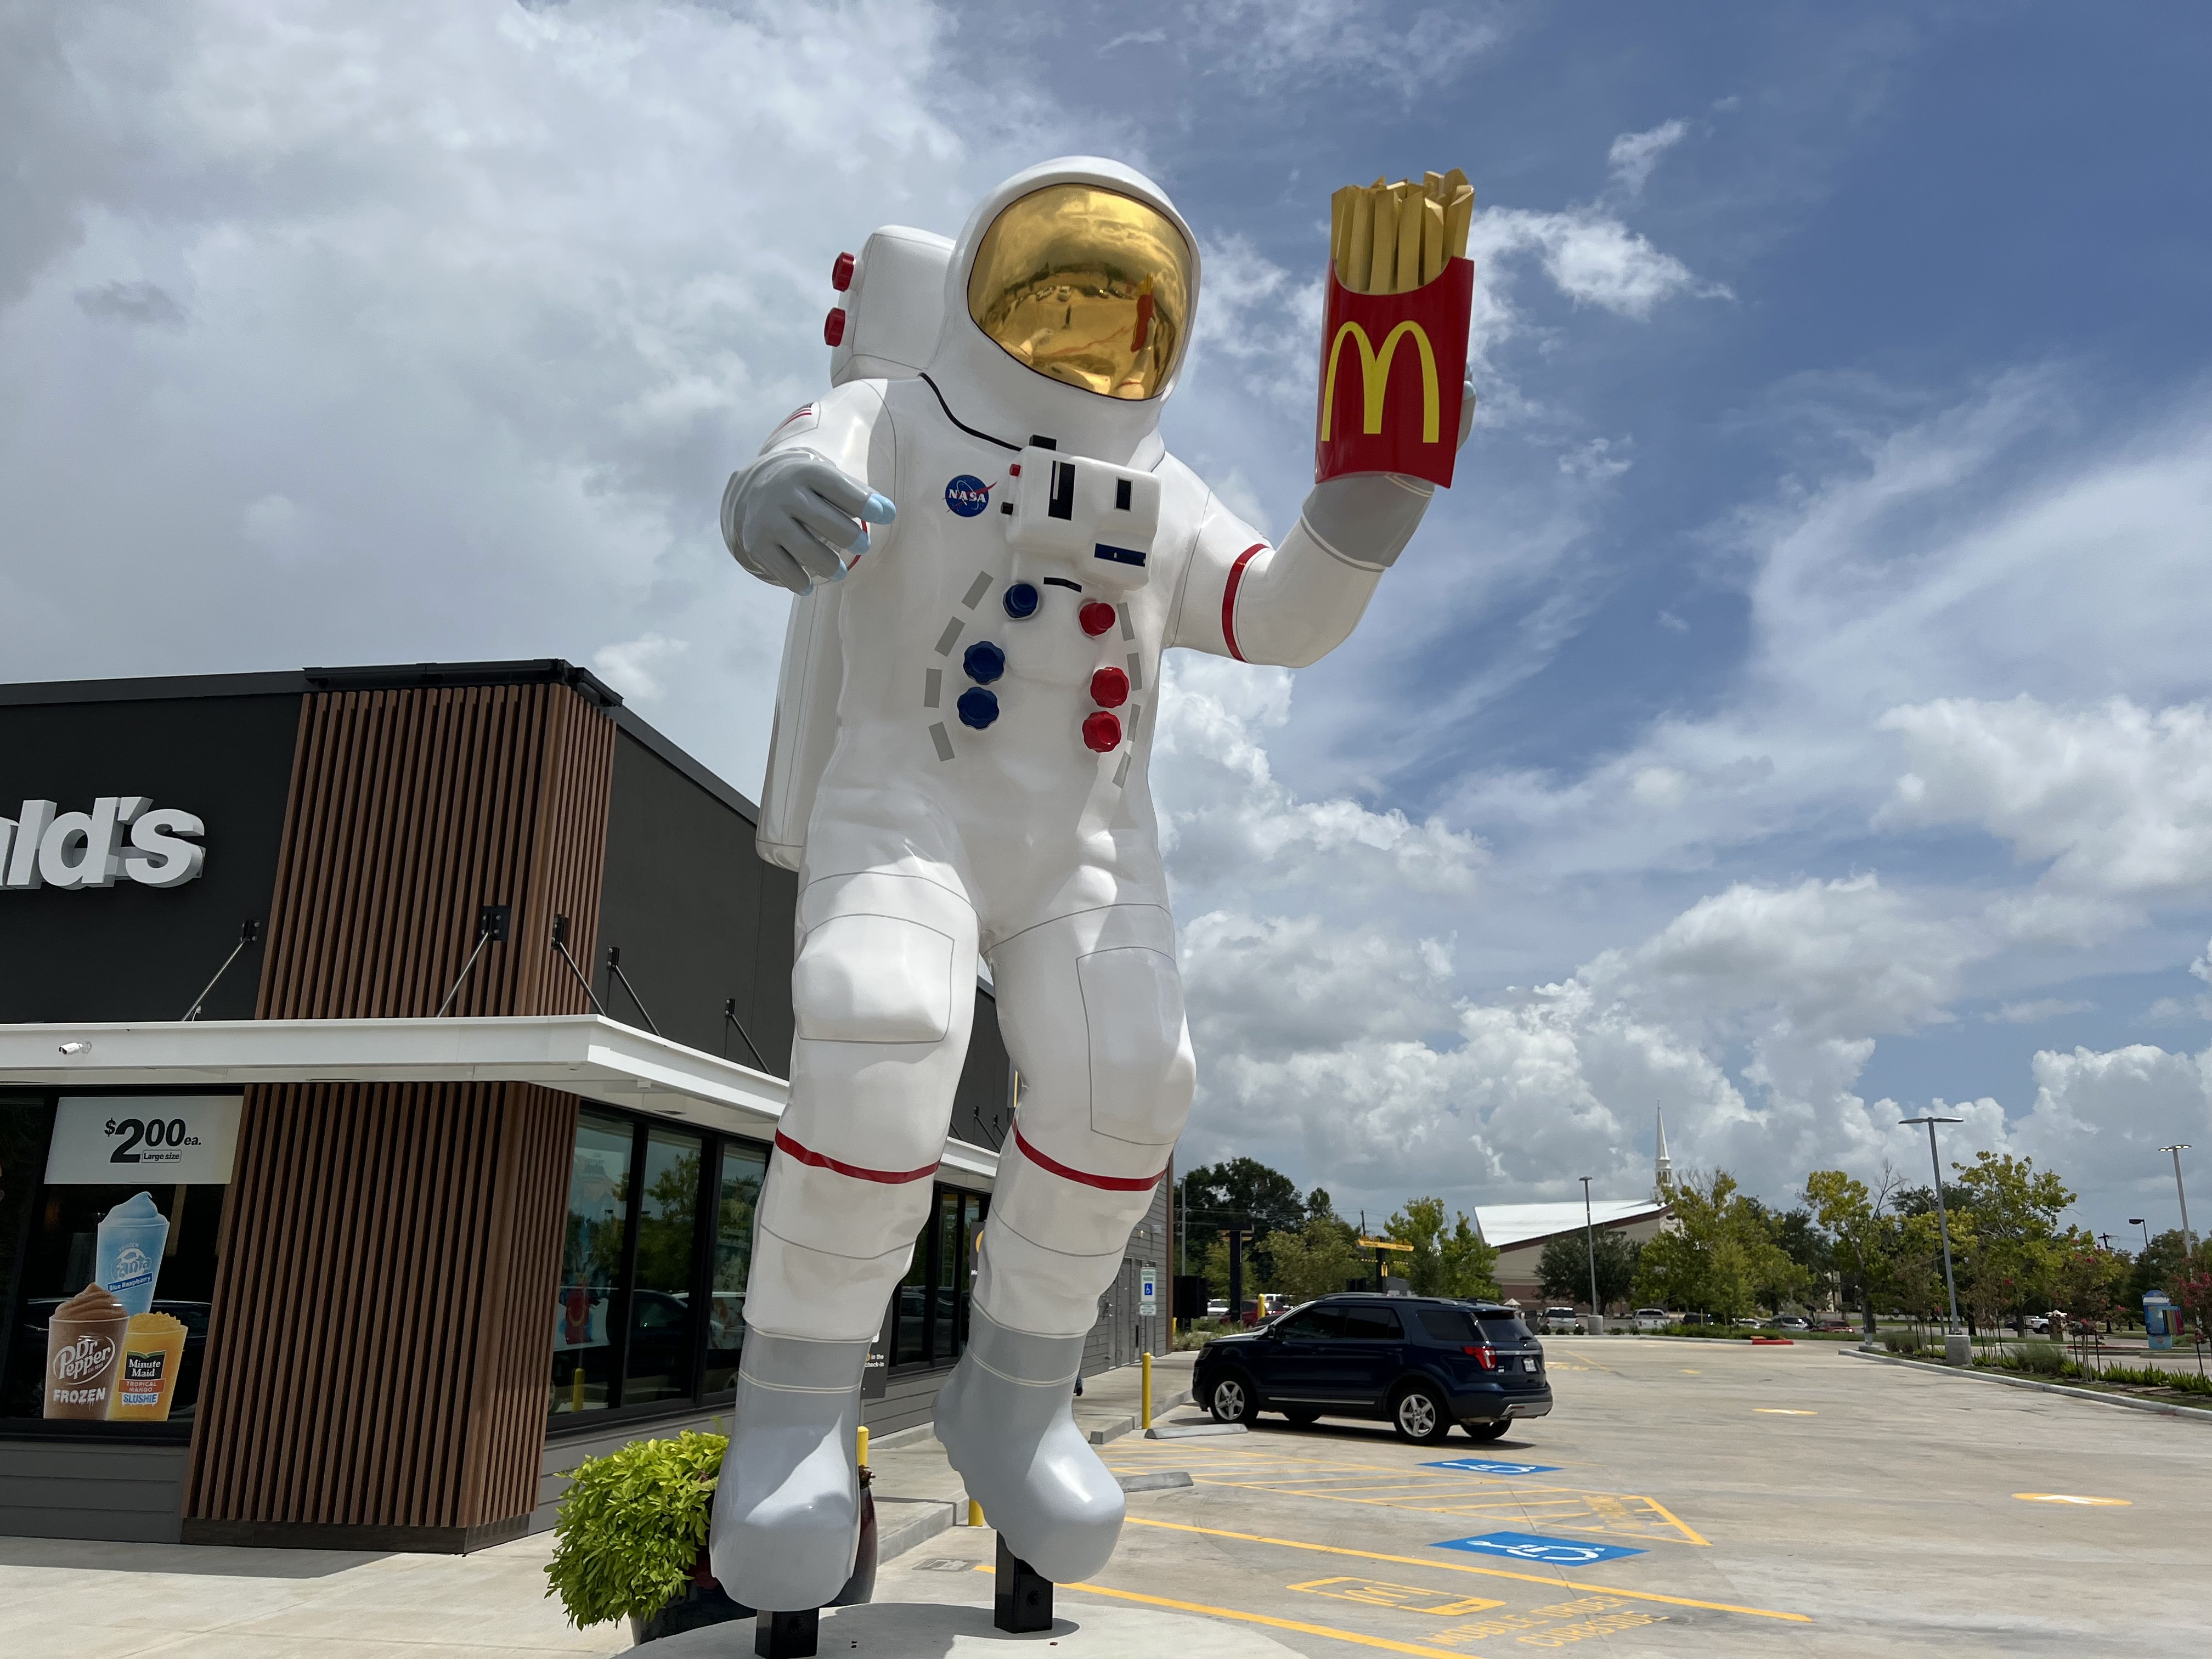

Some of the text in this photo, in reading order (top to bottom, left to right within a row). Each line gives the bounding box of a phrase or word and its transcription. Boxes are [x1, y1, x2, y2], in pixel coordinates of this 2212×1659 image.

[949, 489, 986, 503] NASA
[0, 796, 205, 890] ld's
[143, 1153, 164, 1161] Large
[76, 1340, 98, 1361] Dr
[59, 1346, 111, 1379] Pepper
[128, 1359, 161, 1368] Minute
[131, 1368, 155, 1377] Maid
[53, 1387, 106, 1404] FROZEN
[123, 1394, 157, 1403] SLUSHIE
